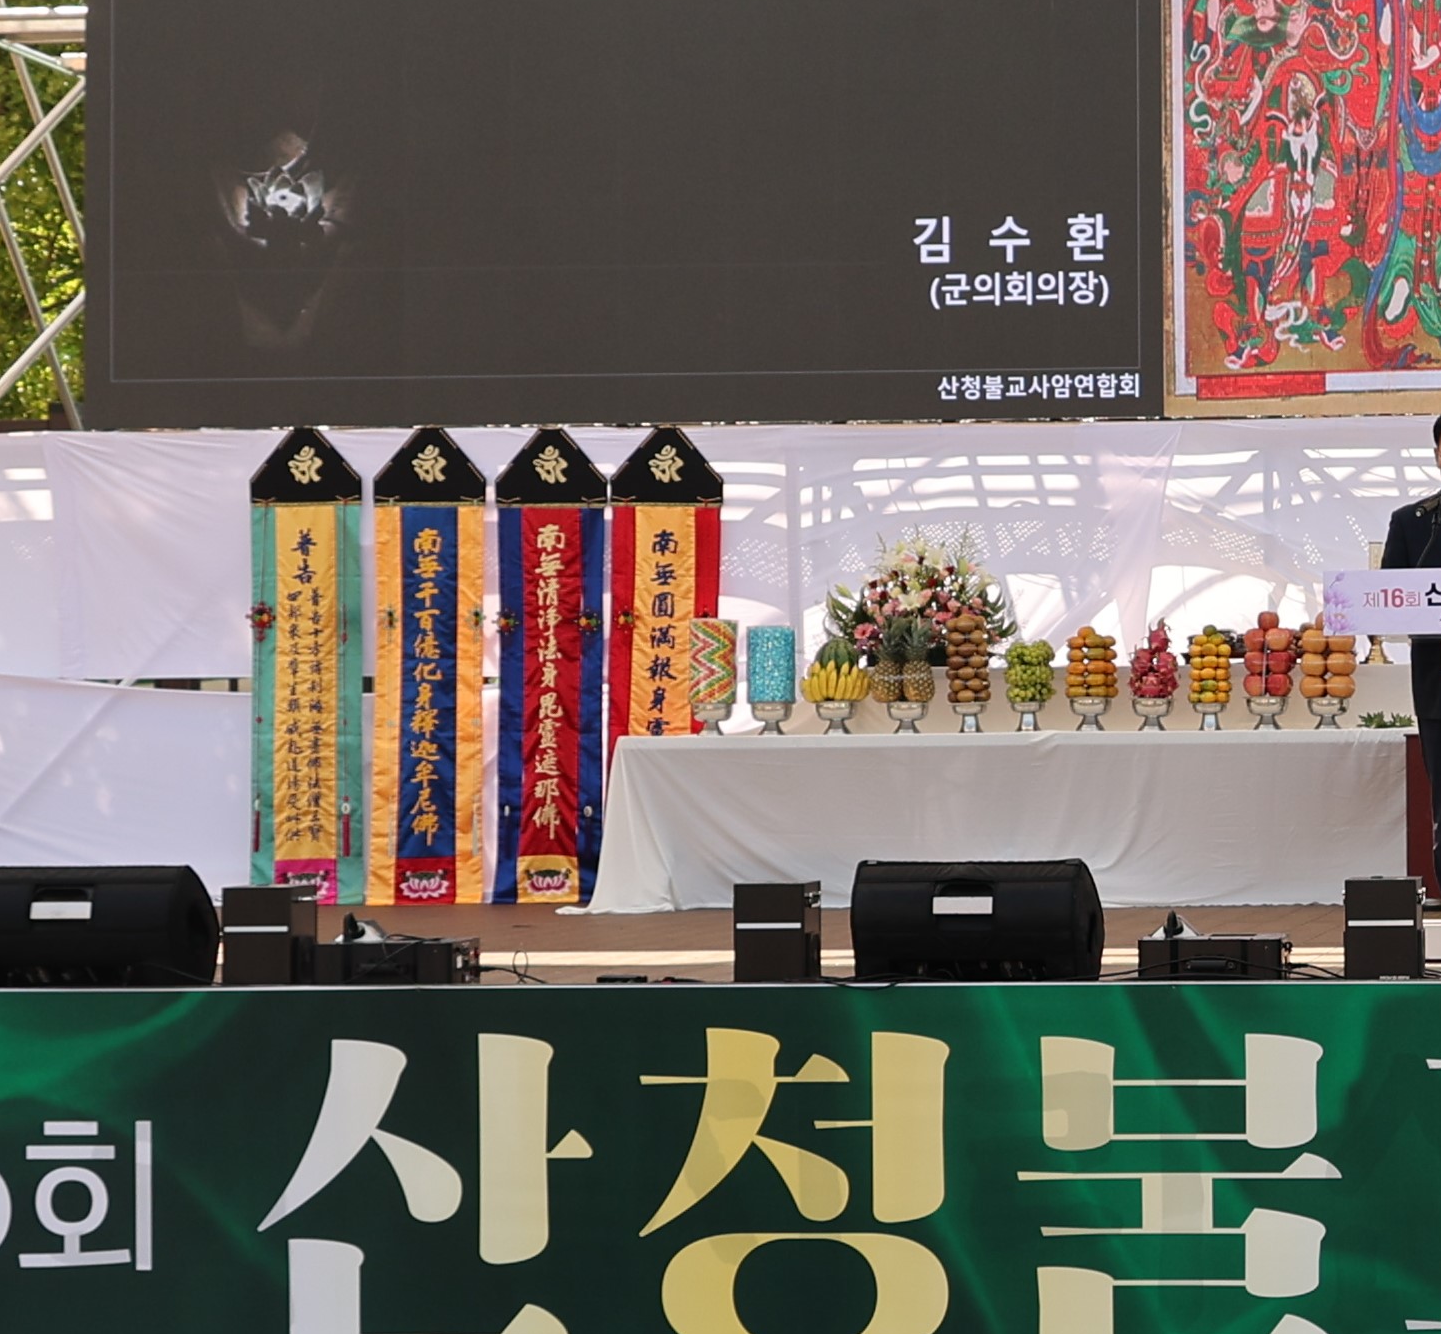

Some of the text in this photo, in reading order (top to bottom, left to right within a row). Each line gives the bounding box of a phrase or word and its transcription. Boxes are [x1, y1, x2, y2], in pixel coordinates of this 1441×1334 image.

[931, 271, 1108, 309] (군의회의장)
[938, 373, 1139, 400] 산청불교사암연합회
[1365, 589, 1420, 607] 제16회
